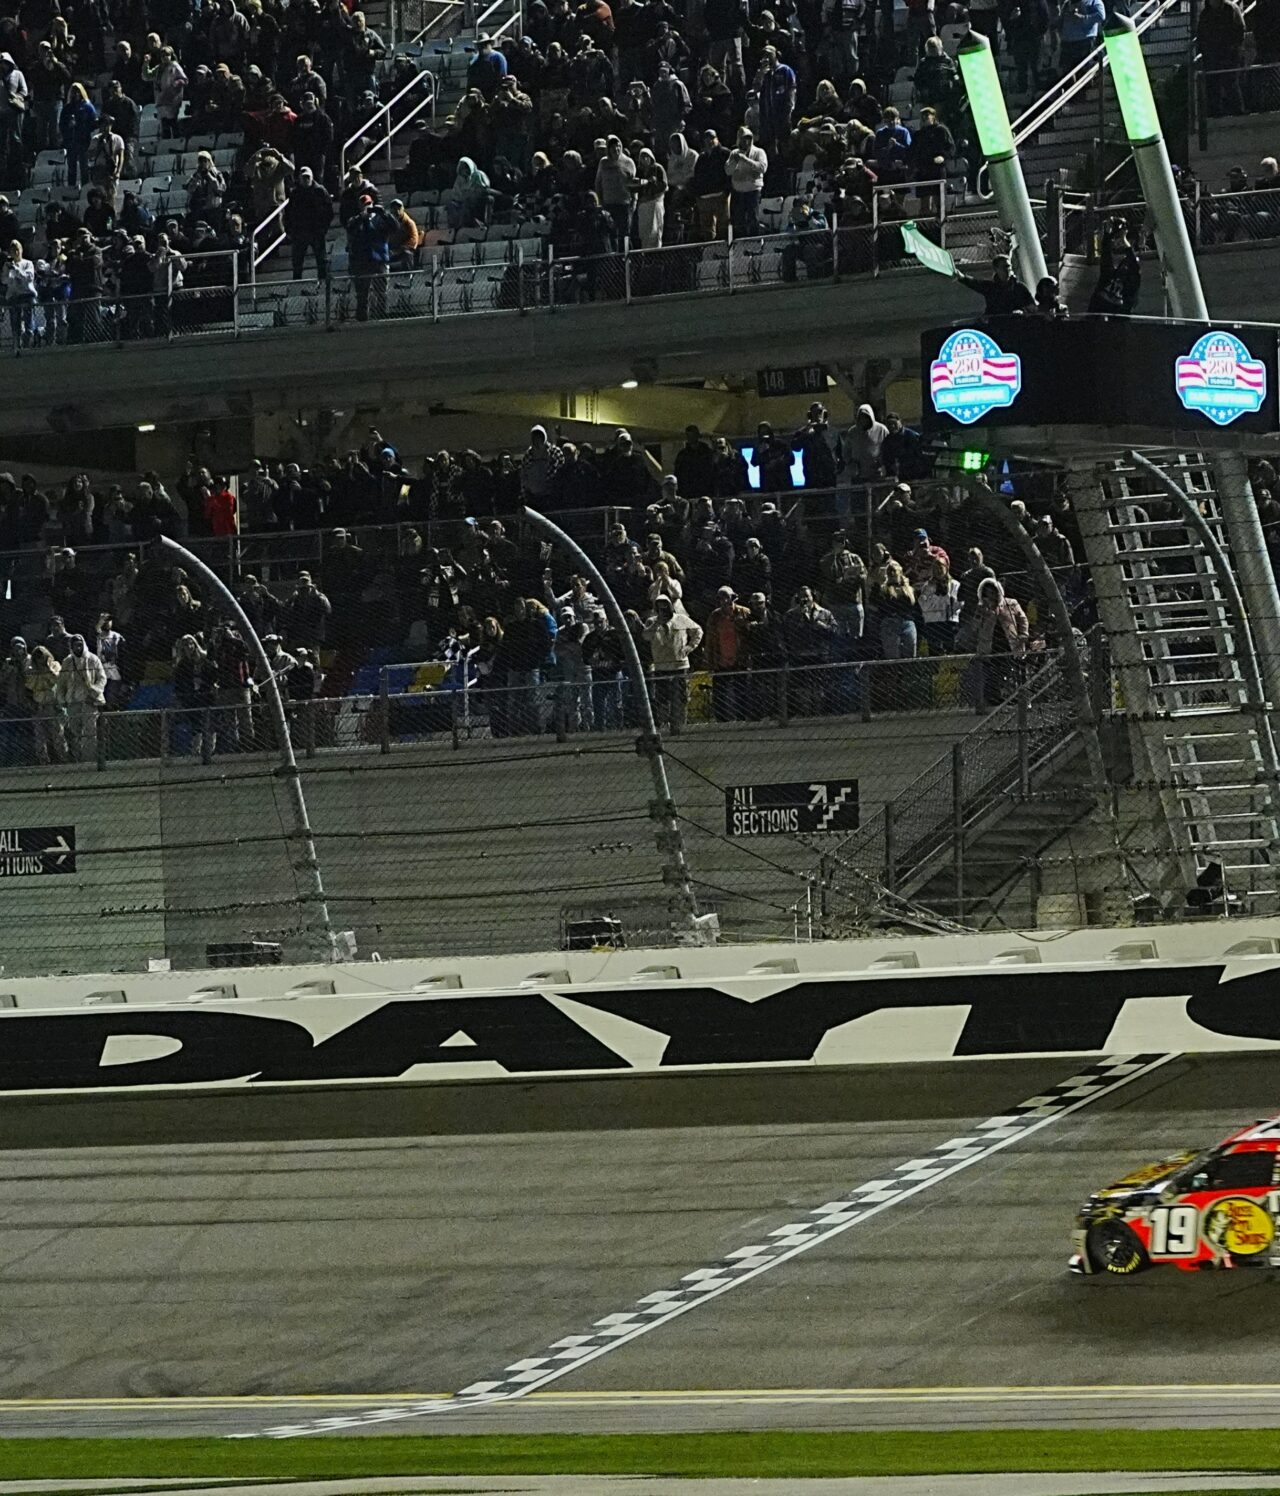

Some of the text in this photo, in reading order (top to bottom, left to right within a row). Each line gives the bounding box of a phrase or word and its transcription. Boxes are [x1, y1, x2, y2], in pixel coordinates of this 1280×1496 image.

[763, 367, 821, 391] 148 147
[733, 787, 757, 810] ALL
[733, 808, 799, 835] SECTIONS
[0, 830, 23, 852] ALL
[1150, 1206, 1198, 1253] 19
